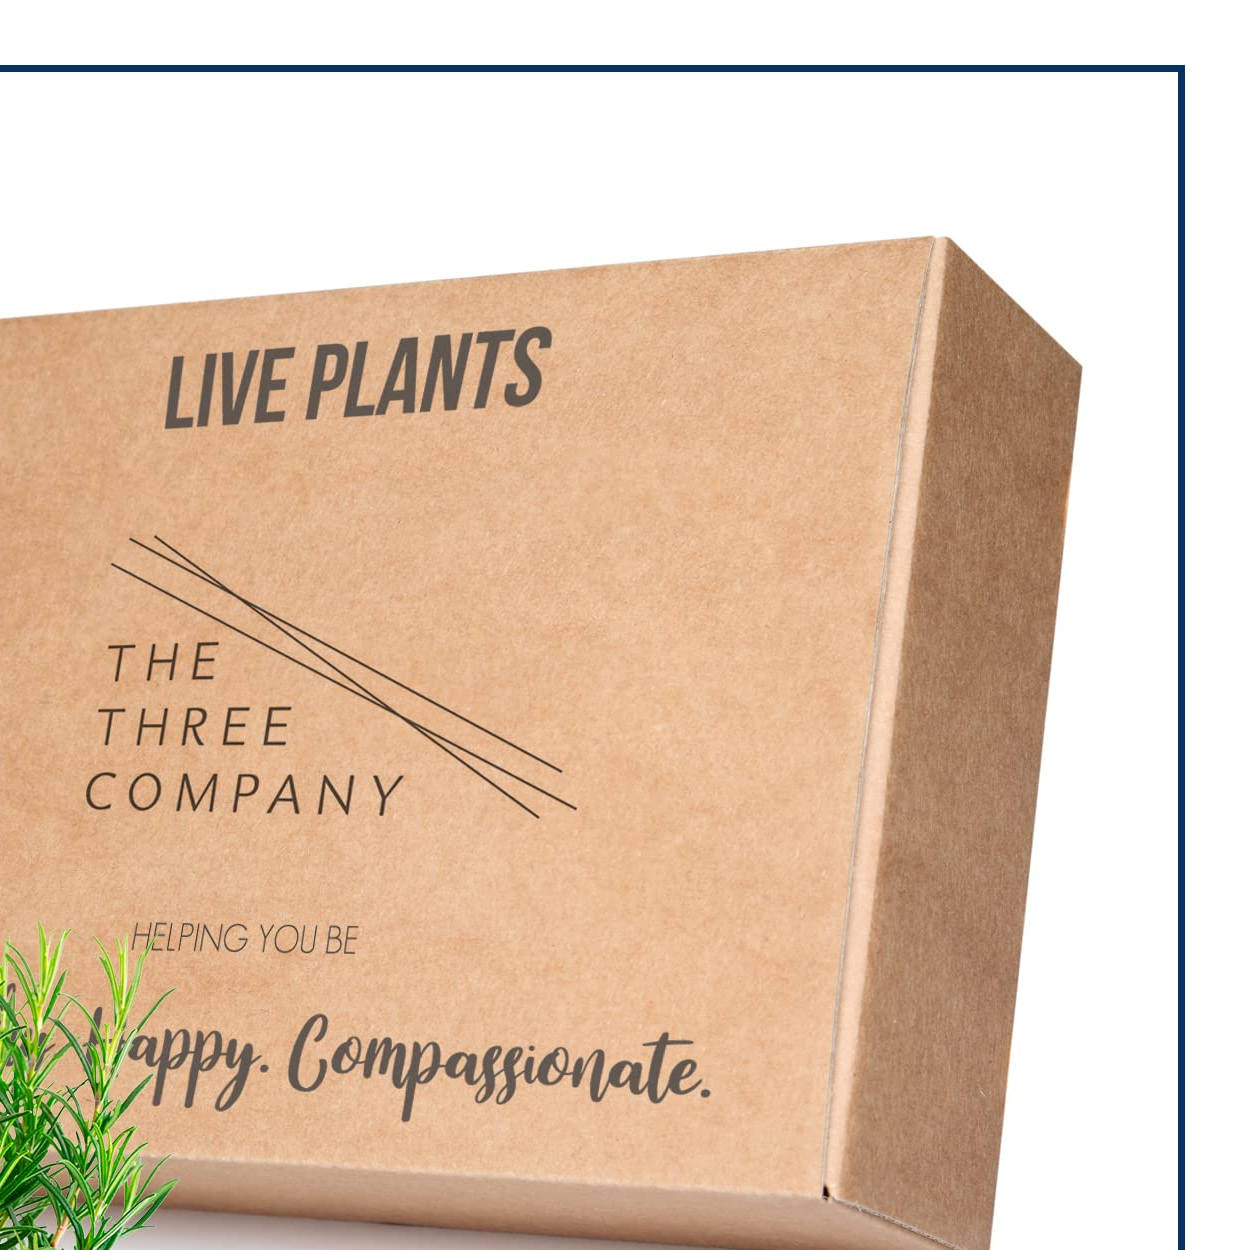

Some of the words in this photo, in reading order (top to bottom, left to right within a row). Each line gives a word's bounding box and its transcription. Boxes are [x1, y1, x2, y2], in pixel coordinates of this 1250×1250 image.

[165, 347, 295, 429] LIVE
[306, 327, 552, 419] PLANTS
[108, 642, 219, 682] THE
[98, 707, 291, 745] THREE
[86, 772, 403, 816] COMPANY
[132, 922, 248, 953] HELPING
[261, 925, 317, 953] YOU
[326, 926, 358, 954] BE
[289, 1014, 710, 1122] Compassionate.
